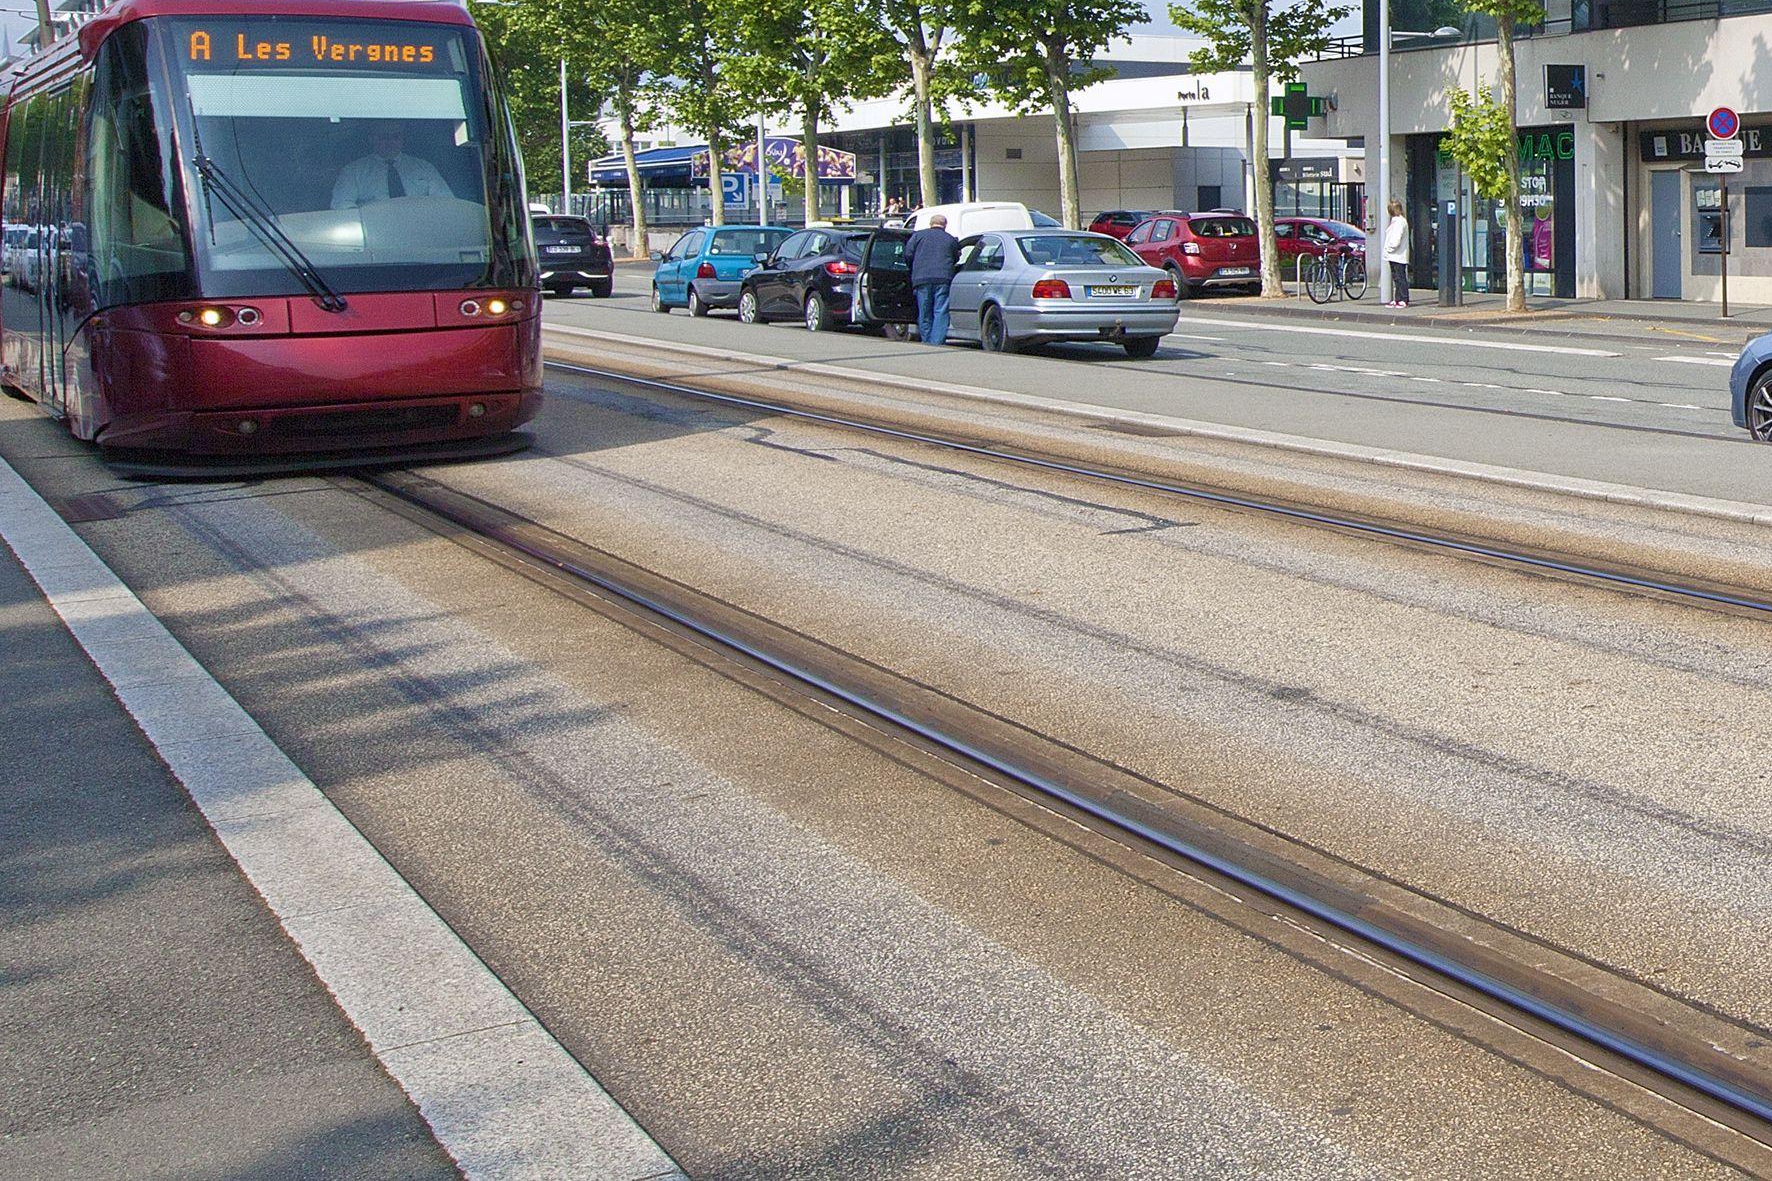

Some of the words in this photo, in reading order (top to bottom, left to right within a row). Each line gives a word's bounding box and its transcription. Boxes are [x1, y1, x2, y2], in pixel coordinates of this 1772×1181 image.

[190, 31, 210, 60] A
[237, 34, 291, 60] Les
[312, 35, 434, 62] Vergnes
[721, 176, 738, 192] P
